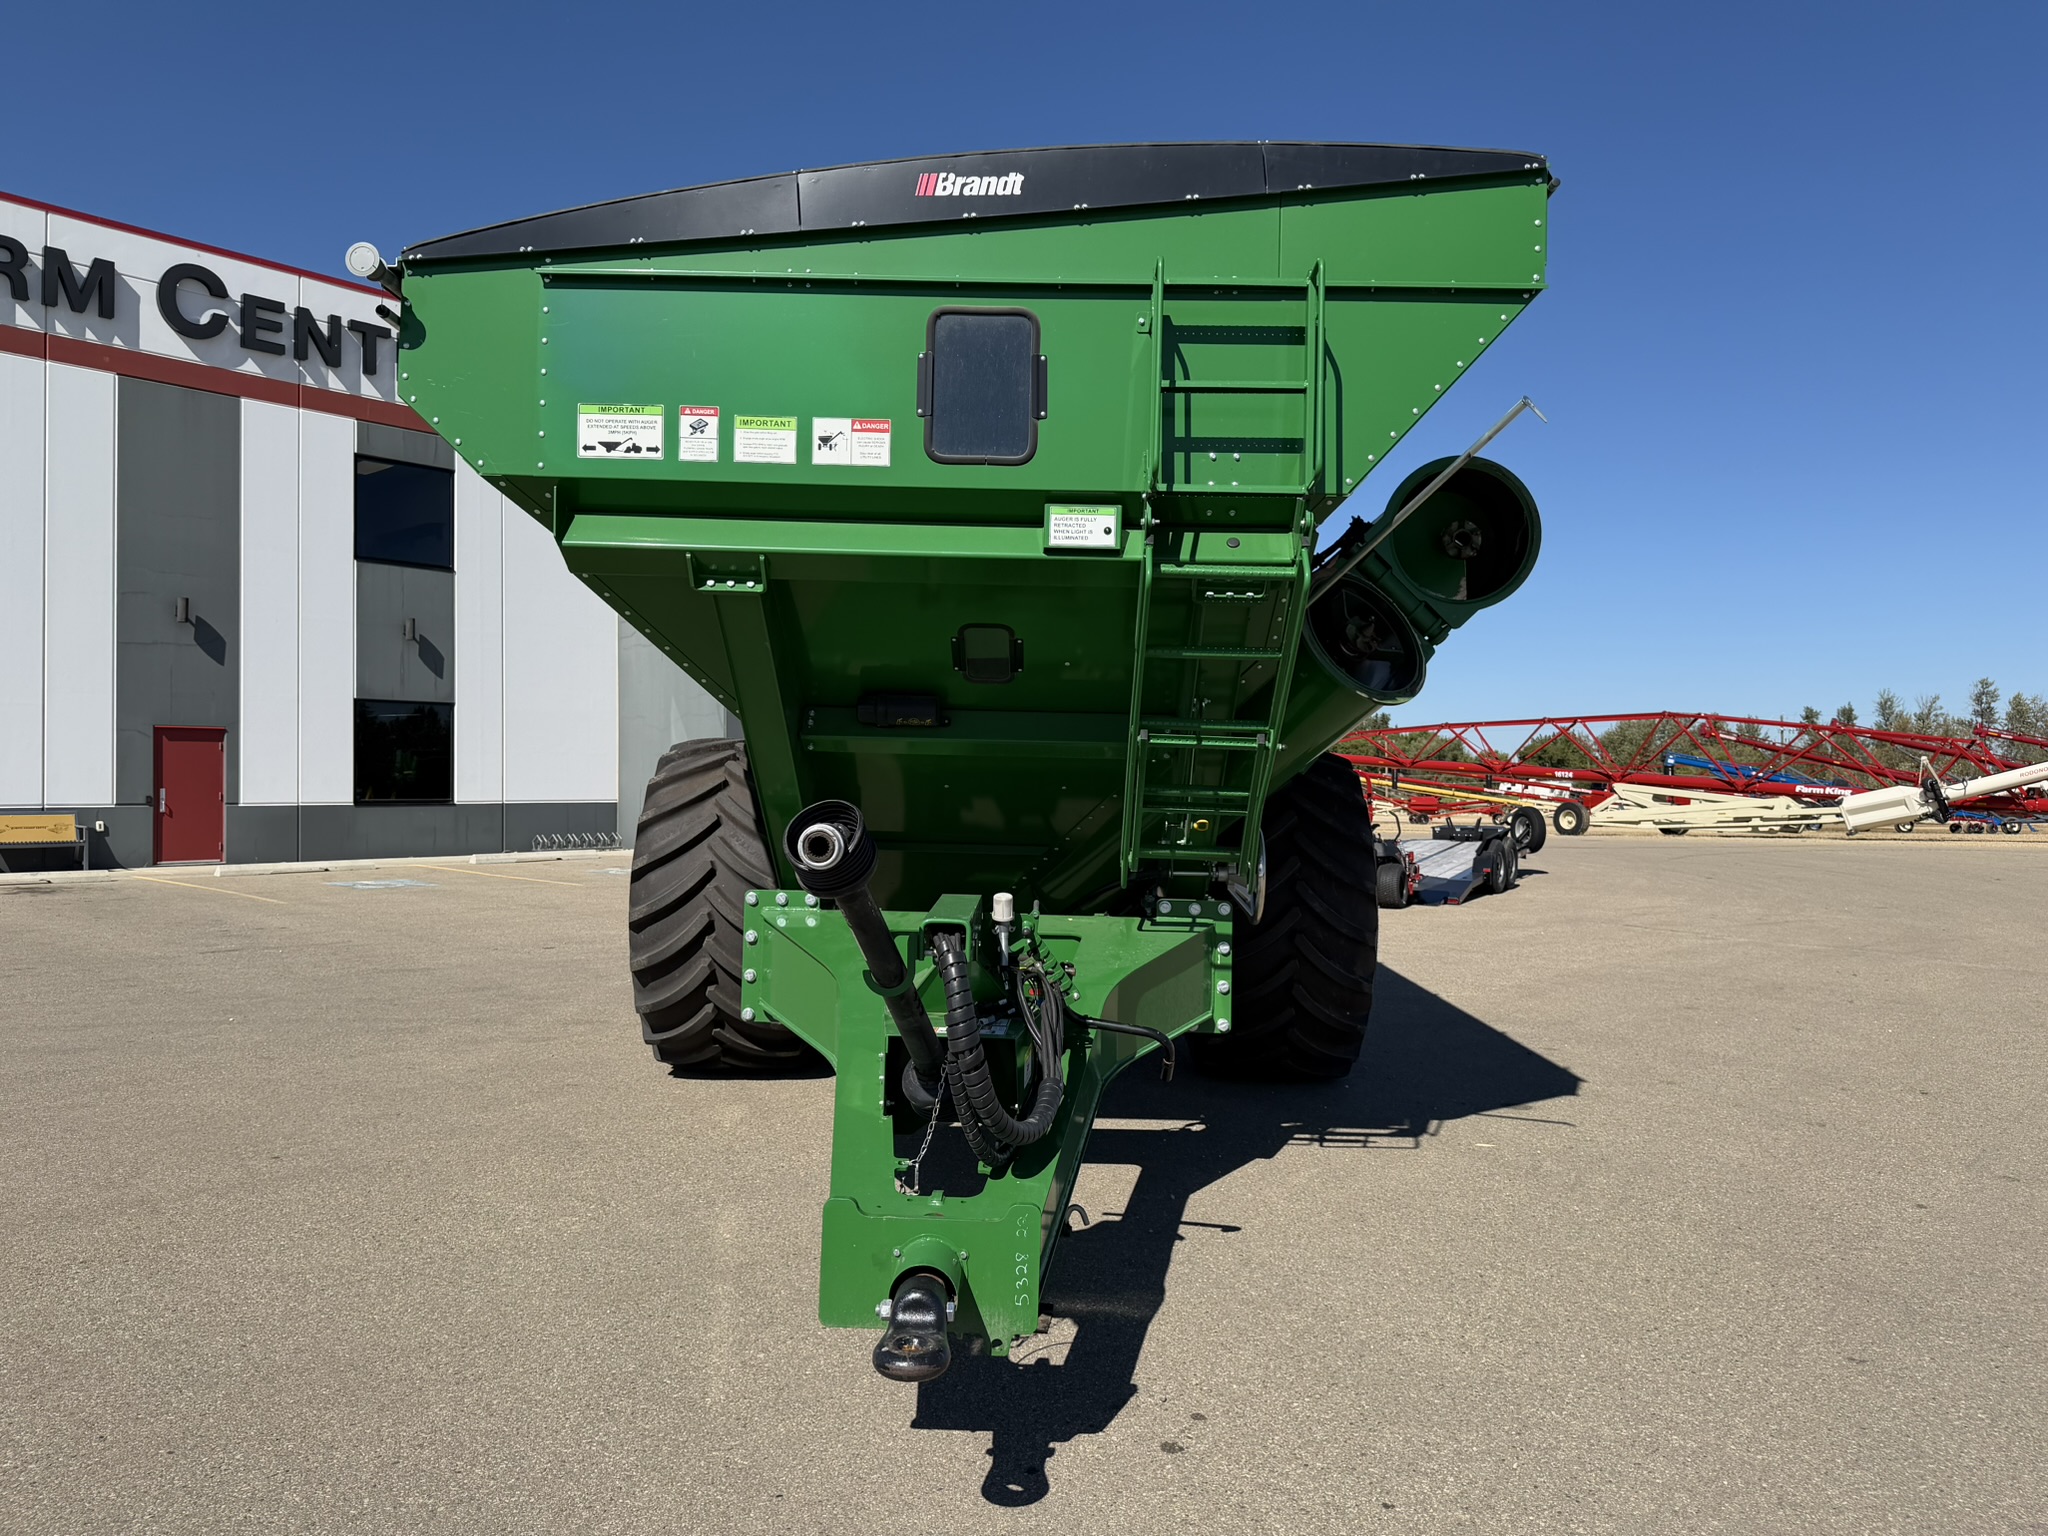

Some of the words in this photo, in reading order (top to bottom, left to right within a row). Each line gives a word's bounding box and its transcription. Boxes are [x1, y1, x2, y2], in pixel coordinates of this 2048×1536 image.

[934, 172, 1025, 196] Brandt
[156, 263, 399, 378] CENT
[739, 419, 792, 427] IMPORTANT
[1795, 785, 1824, 794] Farm
[1825, 786, 1853, 796] King
